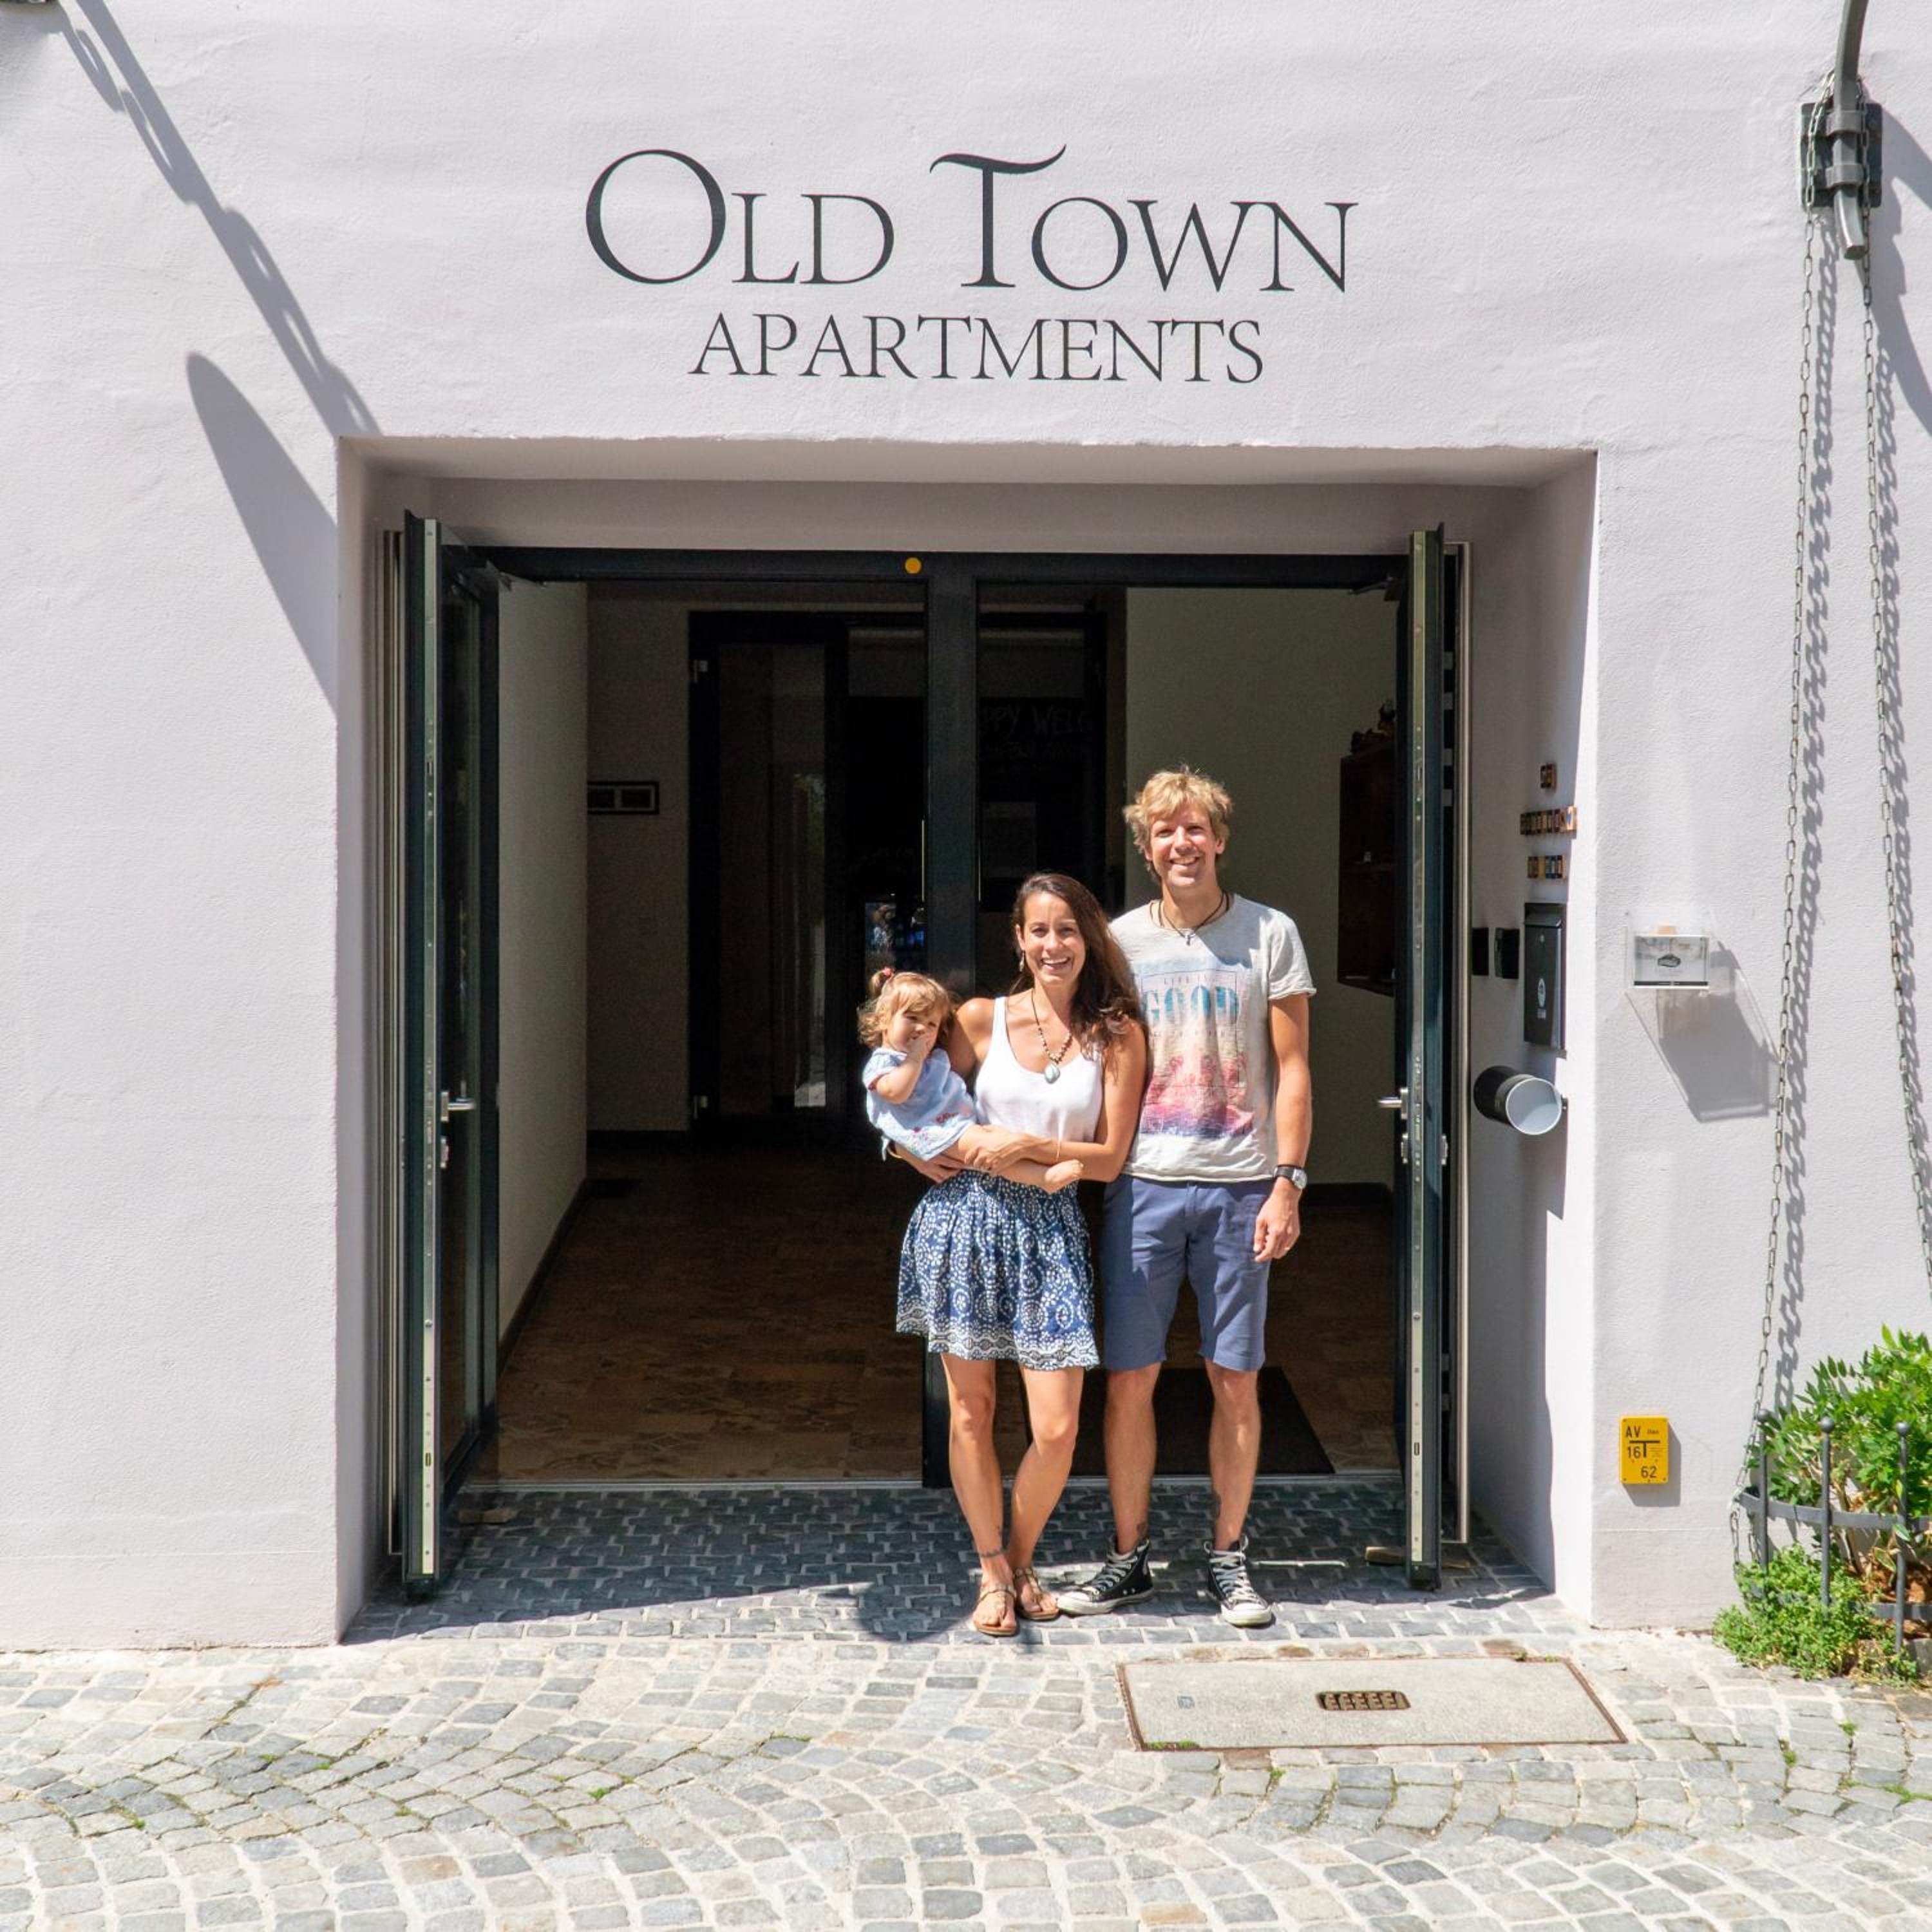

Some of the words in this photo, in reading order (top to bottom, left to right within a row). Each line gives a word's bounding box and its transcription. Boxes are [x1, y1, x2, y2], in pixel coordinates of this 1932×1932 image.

[585, 149, 895, 285] OLD
[929, 144, 1359, 293] TOWN
[688, 312, 1263, 384] APARTMENTS
[1625, 1425, 1641, 1438] AV
[1627, 1446, 1641, 1459] 16
[1640, 1466, 1657, 1478] 62
